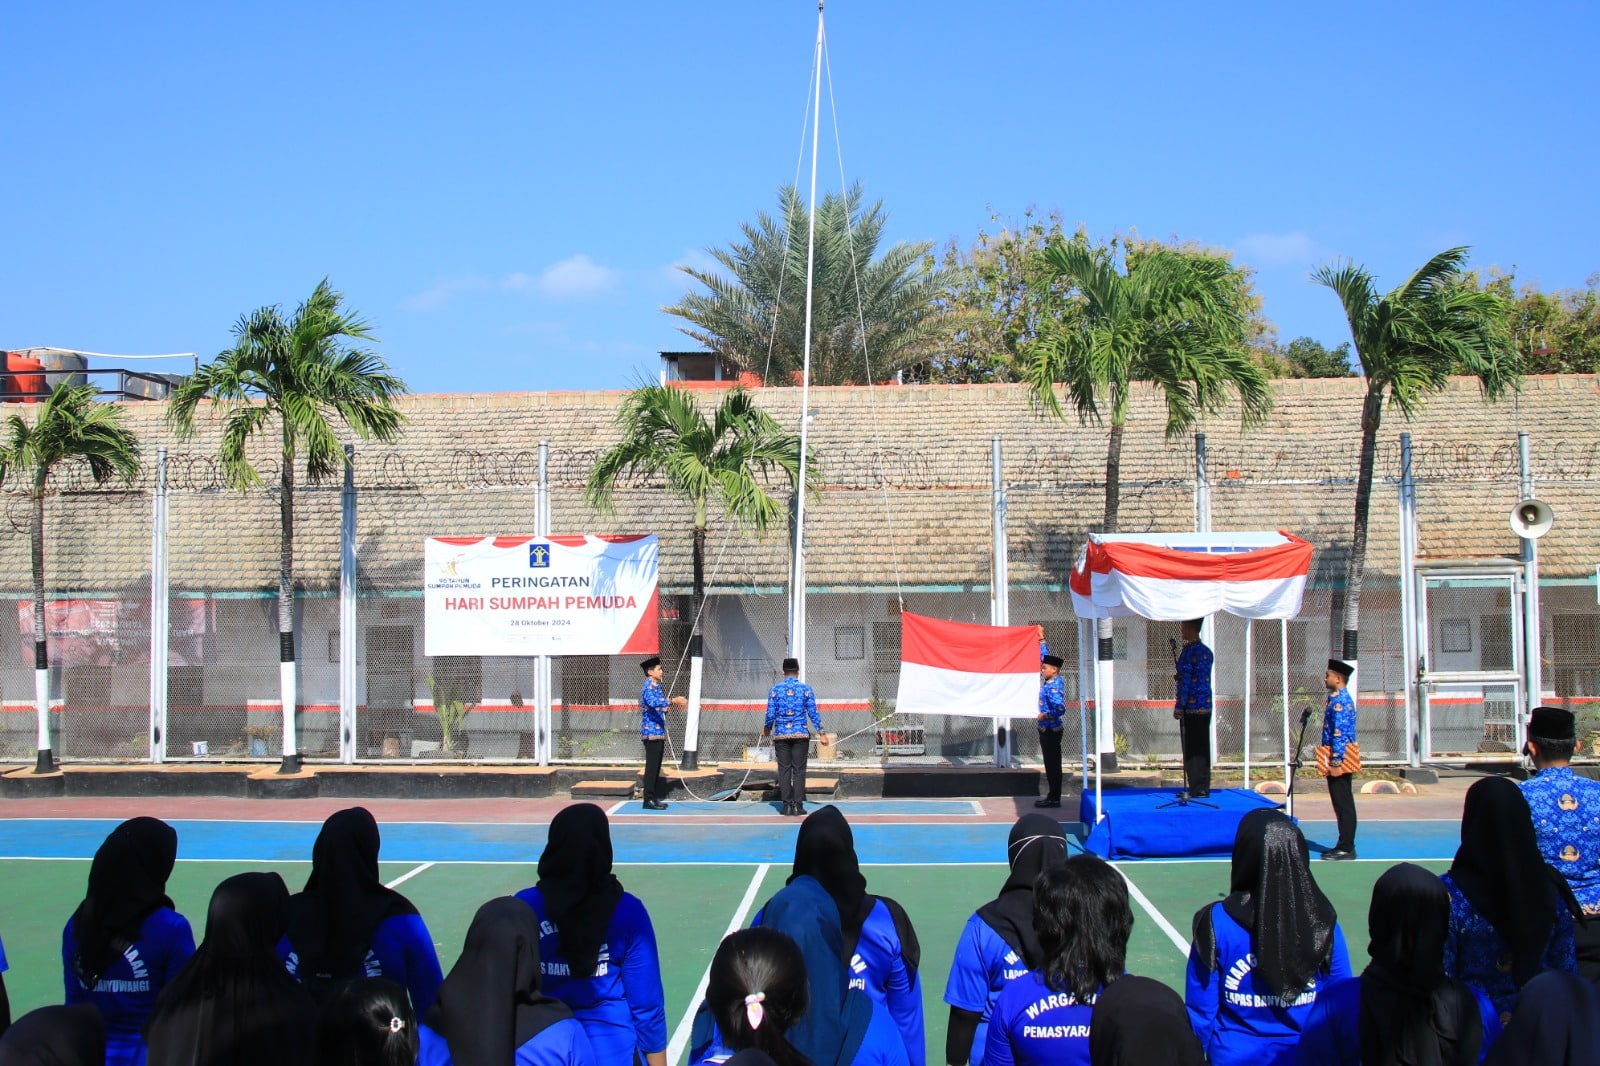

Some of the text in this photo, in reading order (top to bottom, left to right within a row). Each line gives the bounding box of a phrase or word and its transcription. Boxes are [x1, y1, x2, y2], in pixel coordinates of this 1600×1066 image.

[491, 576, 590, 588] PERINGATAN
[445, 595, 637, 610] HARI SUMPAH PEMUDA
[93, 979, 150, 993] ANYUWANGI
